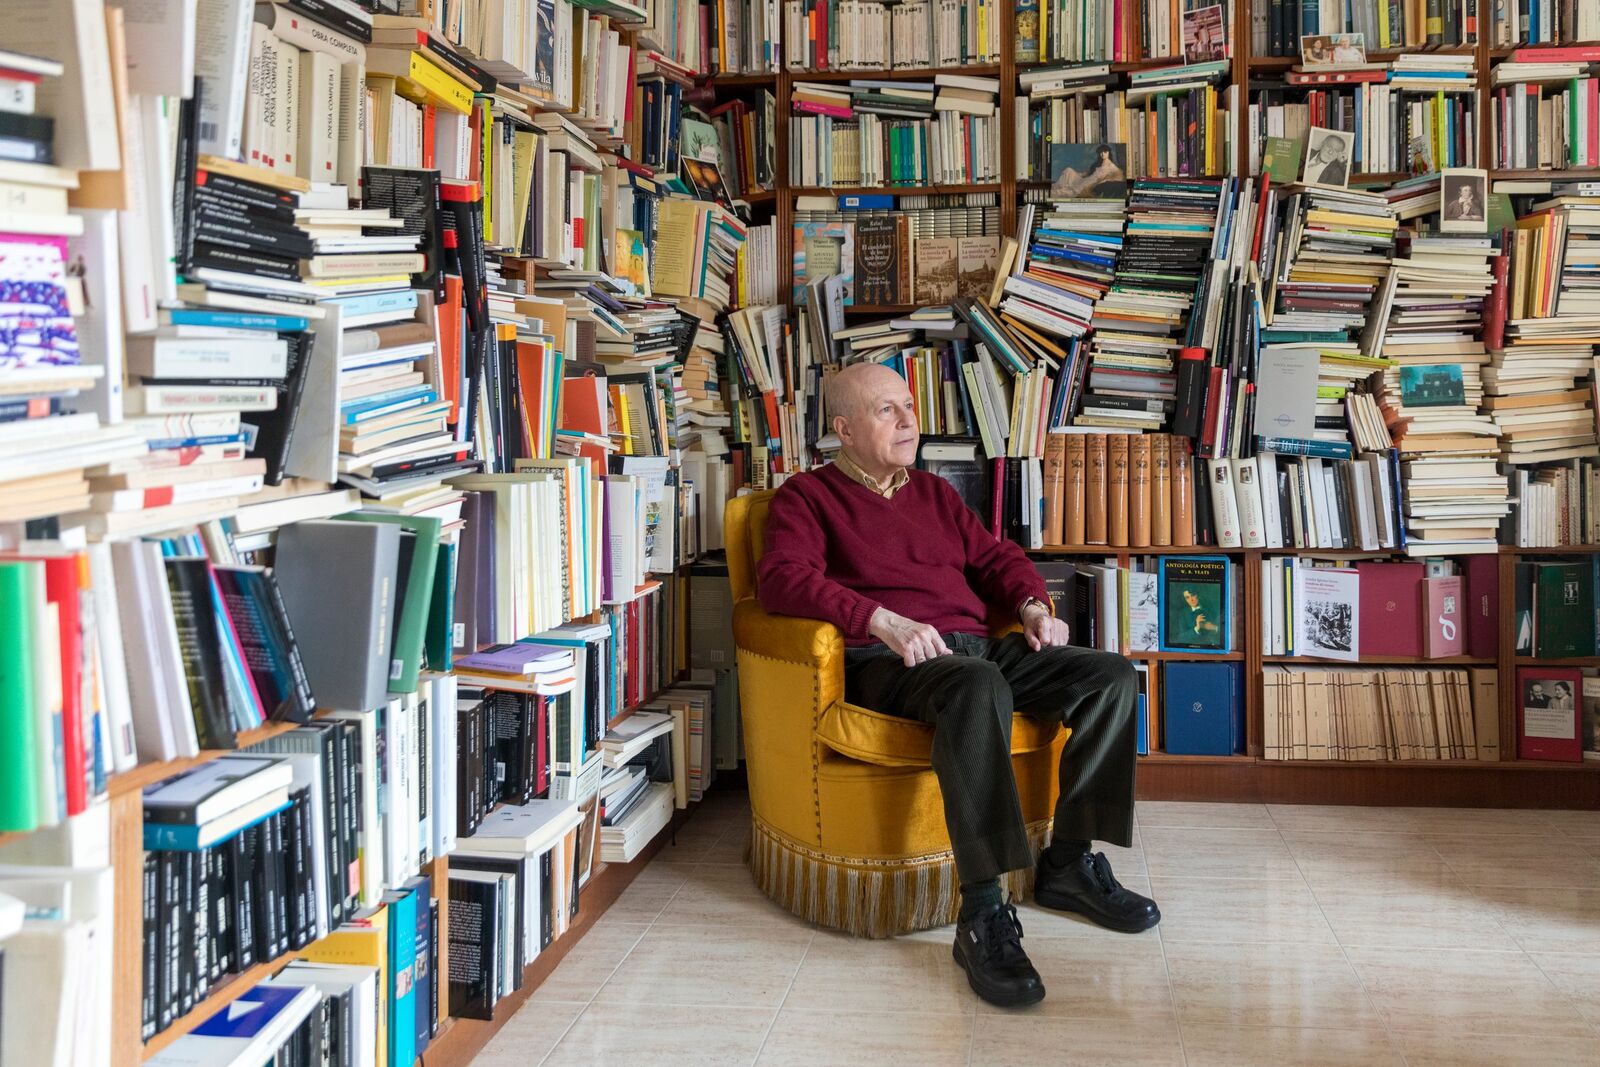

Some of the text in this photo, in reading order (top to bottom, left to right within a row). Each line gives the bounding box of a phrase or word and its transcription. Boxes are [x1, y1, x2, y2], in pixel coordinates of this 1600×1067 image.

[311, 28, 358, 56] OBRA COMPLETA
[535, 70, 552, 85] vila
[990, 247, 997, 258] 2
